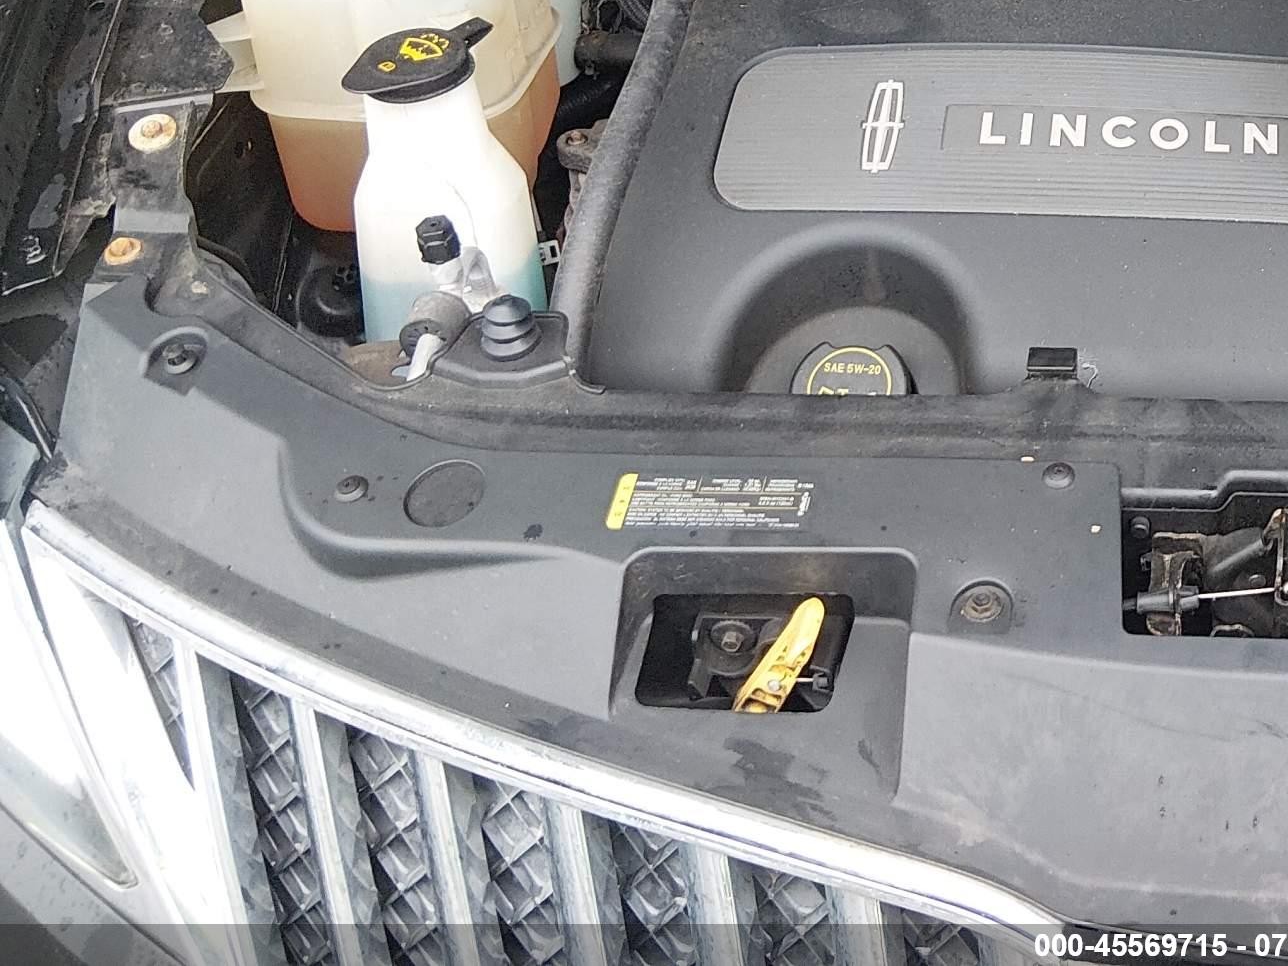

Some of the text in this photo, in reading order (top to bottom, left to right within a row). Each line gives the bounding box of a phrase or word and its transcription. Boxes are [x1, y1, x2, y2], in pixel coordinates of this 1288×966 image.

[978, 111, 1279, 156] LINCOLN
[824, 362, 882, 375] SAE 5W-20
